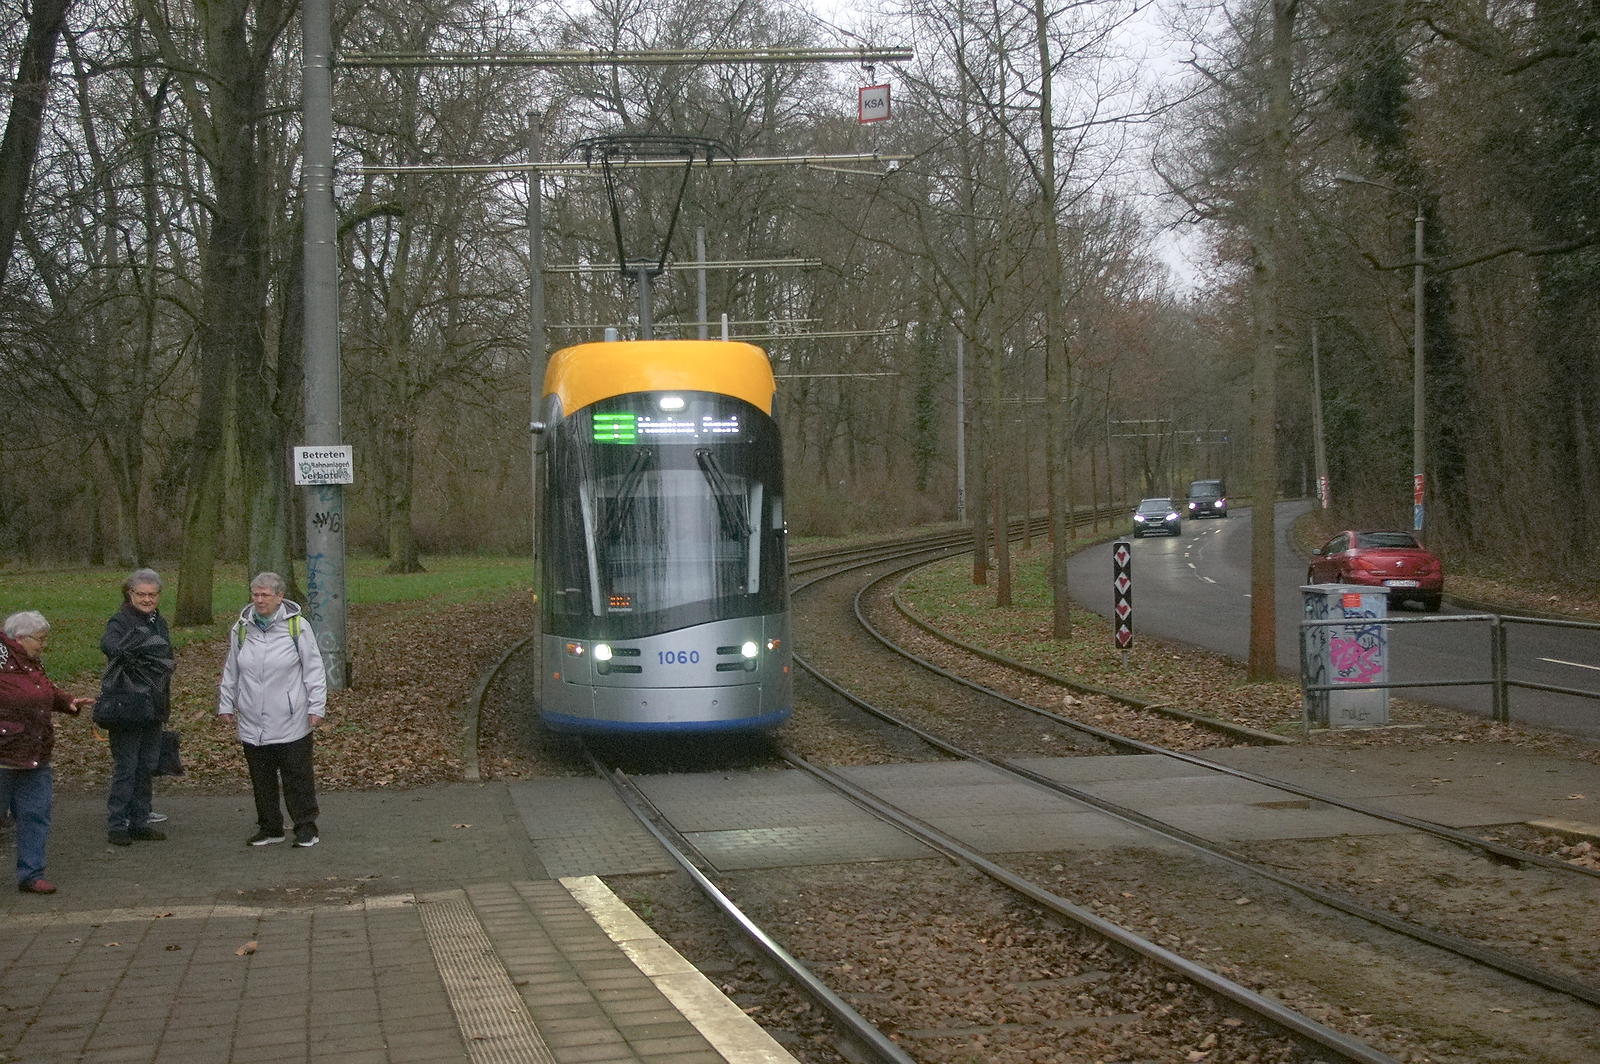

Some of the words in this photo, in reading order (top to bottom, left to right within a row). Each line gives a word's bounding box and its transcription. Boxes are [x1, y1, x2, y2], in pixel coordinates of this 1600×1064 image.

[864, 99, 884, 109] KSA
[302, 451, 345, 459] Betreten
[311, 461, 350, 469] Bahnanlagen
[658, 650, 700, 665] 1060
